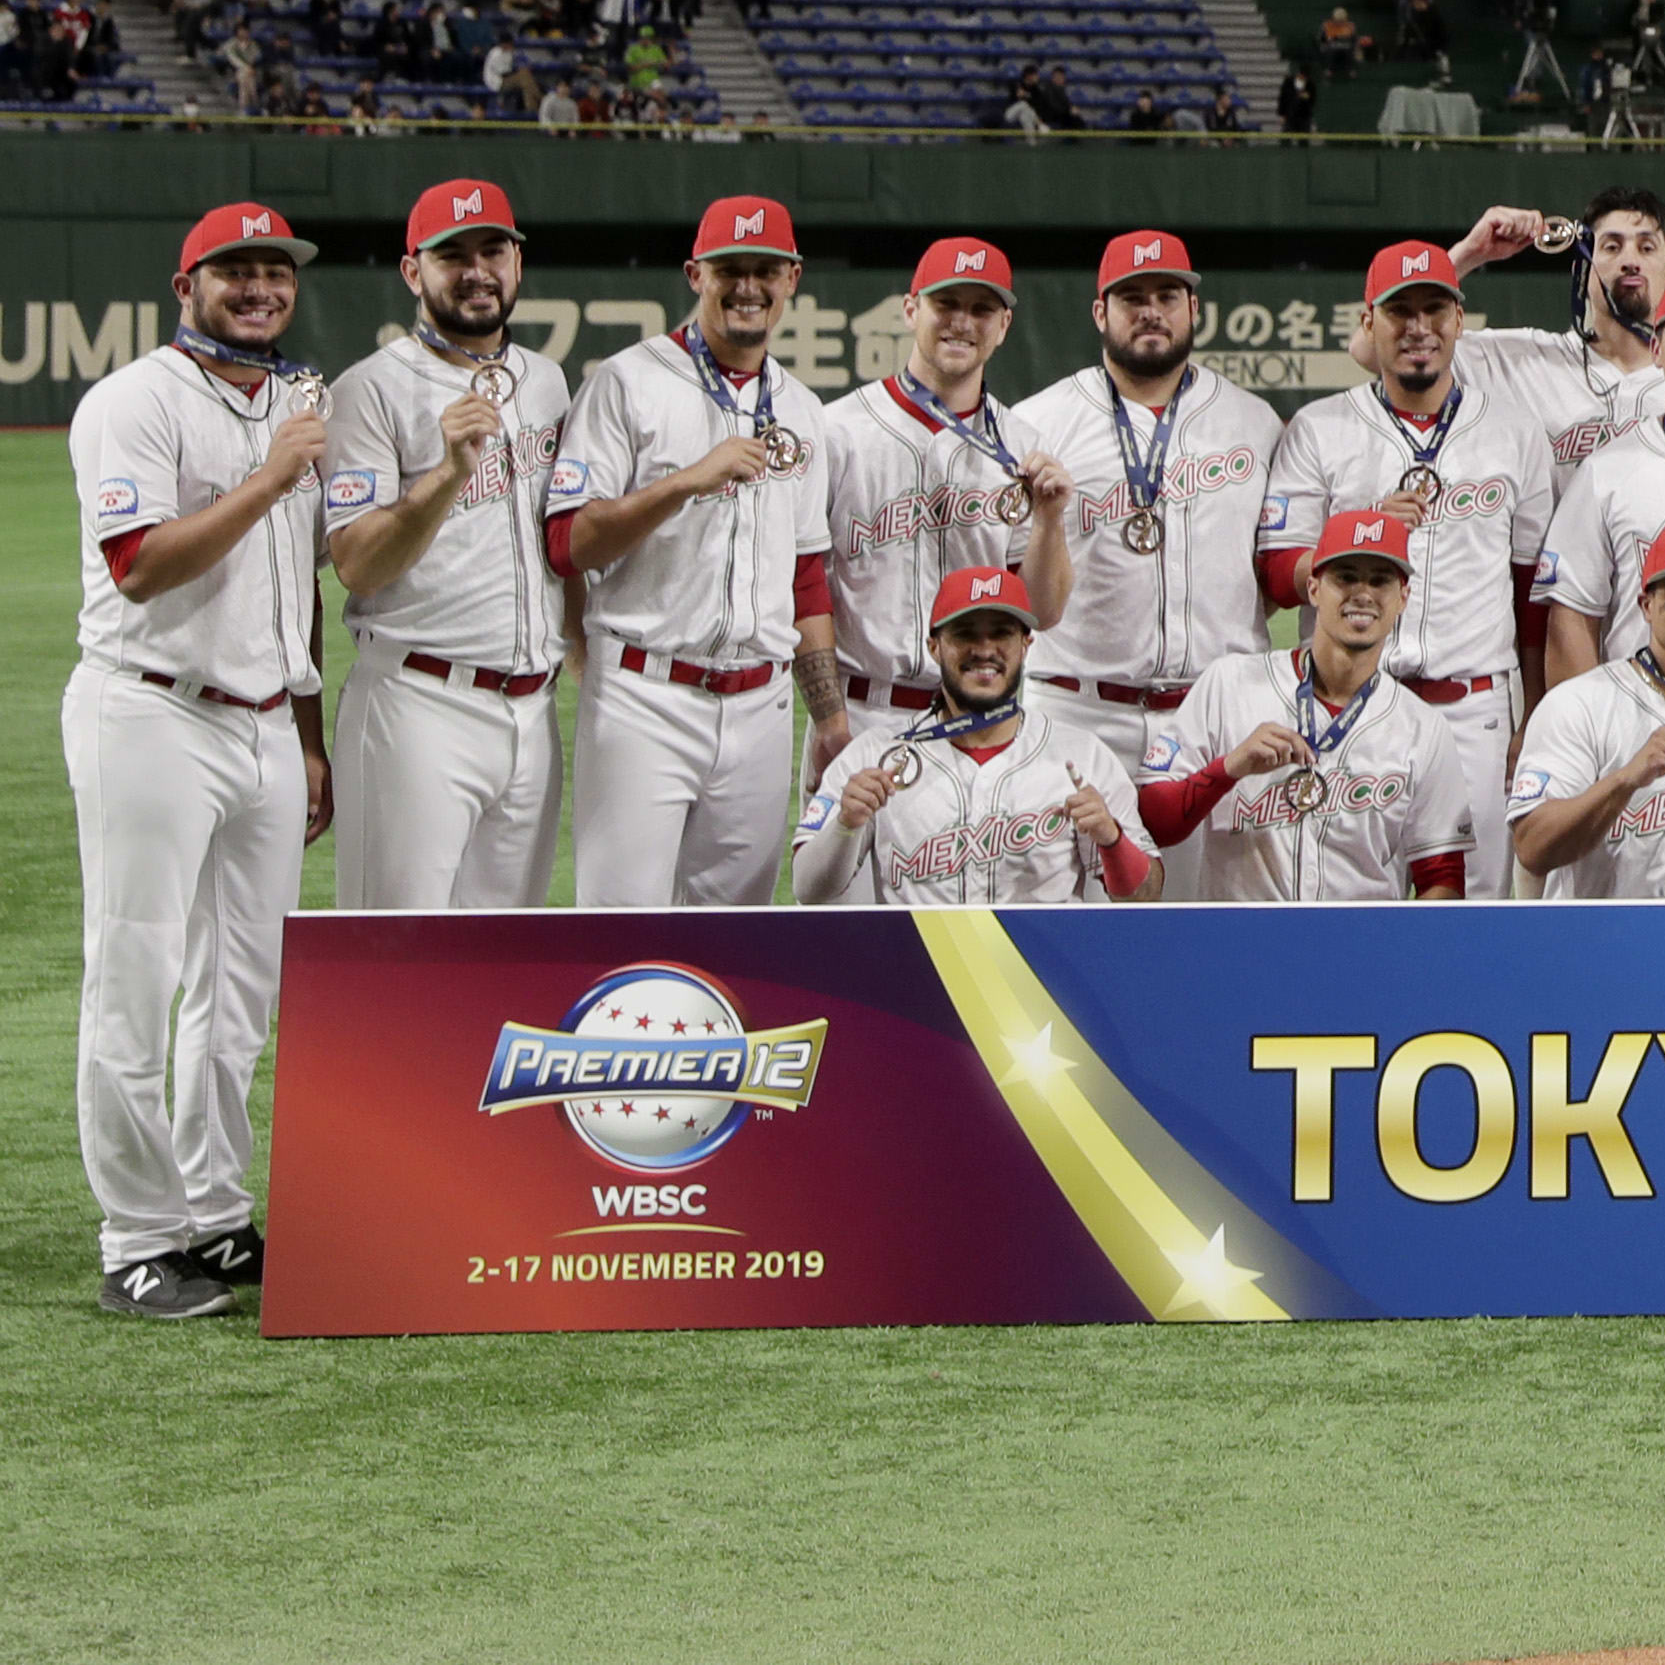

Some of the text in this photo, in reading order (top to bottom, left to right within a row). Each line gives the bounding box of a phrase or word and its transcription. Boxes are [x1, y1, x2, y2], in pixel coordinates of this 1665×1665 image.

[499, 1038, 813, 1091] PREMIER 12
[755, 1109, 773, 1121] TM
[592, 1185, 707, 1218] WBSC
[467, 1250, 824, 1283] 2-17 NOVEMBER 2019
